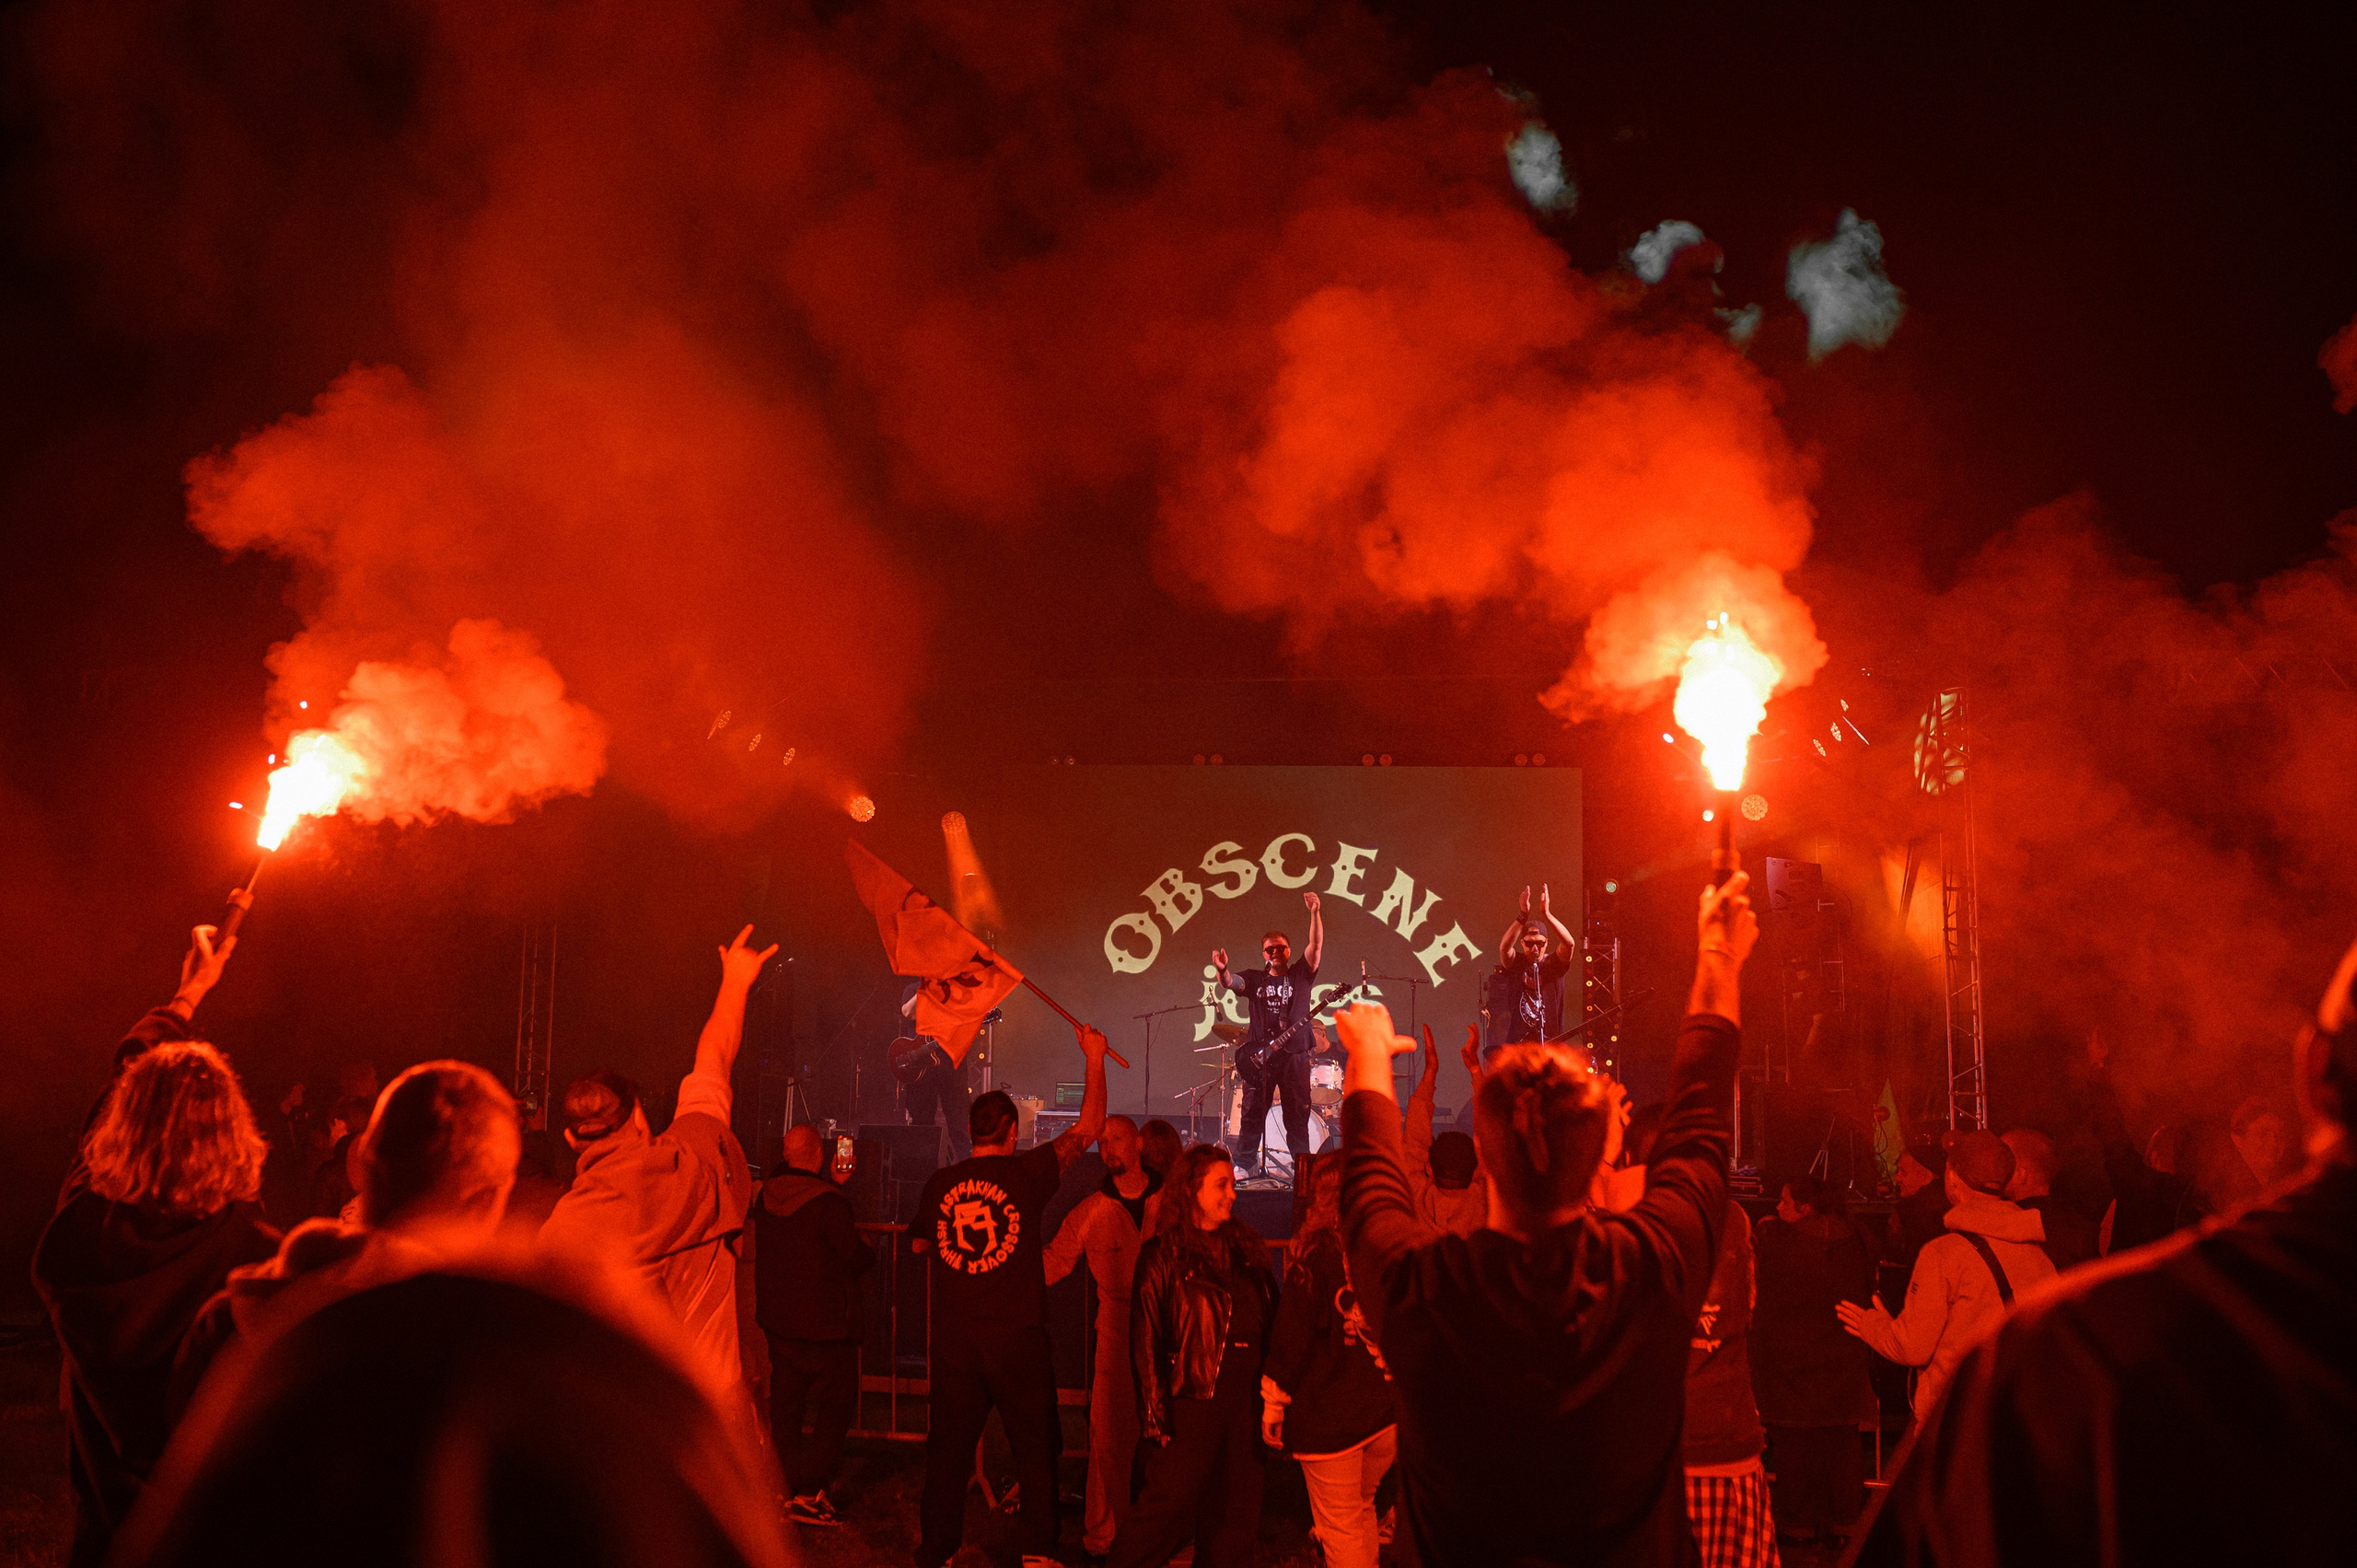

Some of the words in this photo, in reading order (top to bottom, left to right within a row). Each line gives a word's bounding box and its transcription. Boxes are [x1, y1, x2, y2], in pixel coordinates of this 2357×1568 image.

[1103, 832, 1483, 988] OBSCENE
[939, 1178, 1007, 1218] ASTRAKHAN
[936, 1219, 963, 1271] THRASH
[967, 1203, 1020, 1275] CROSSOVER
